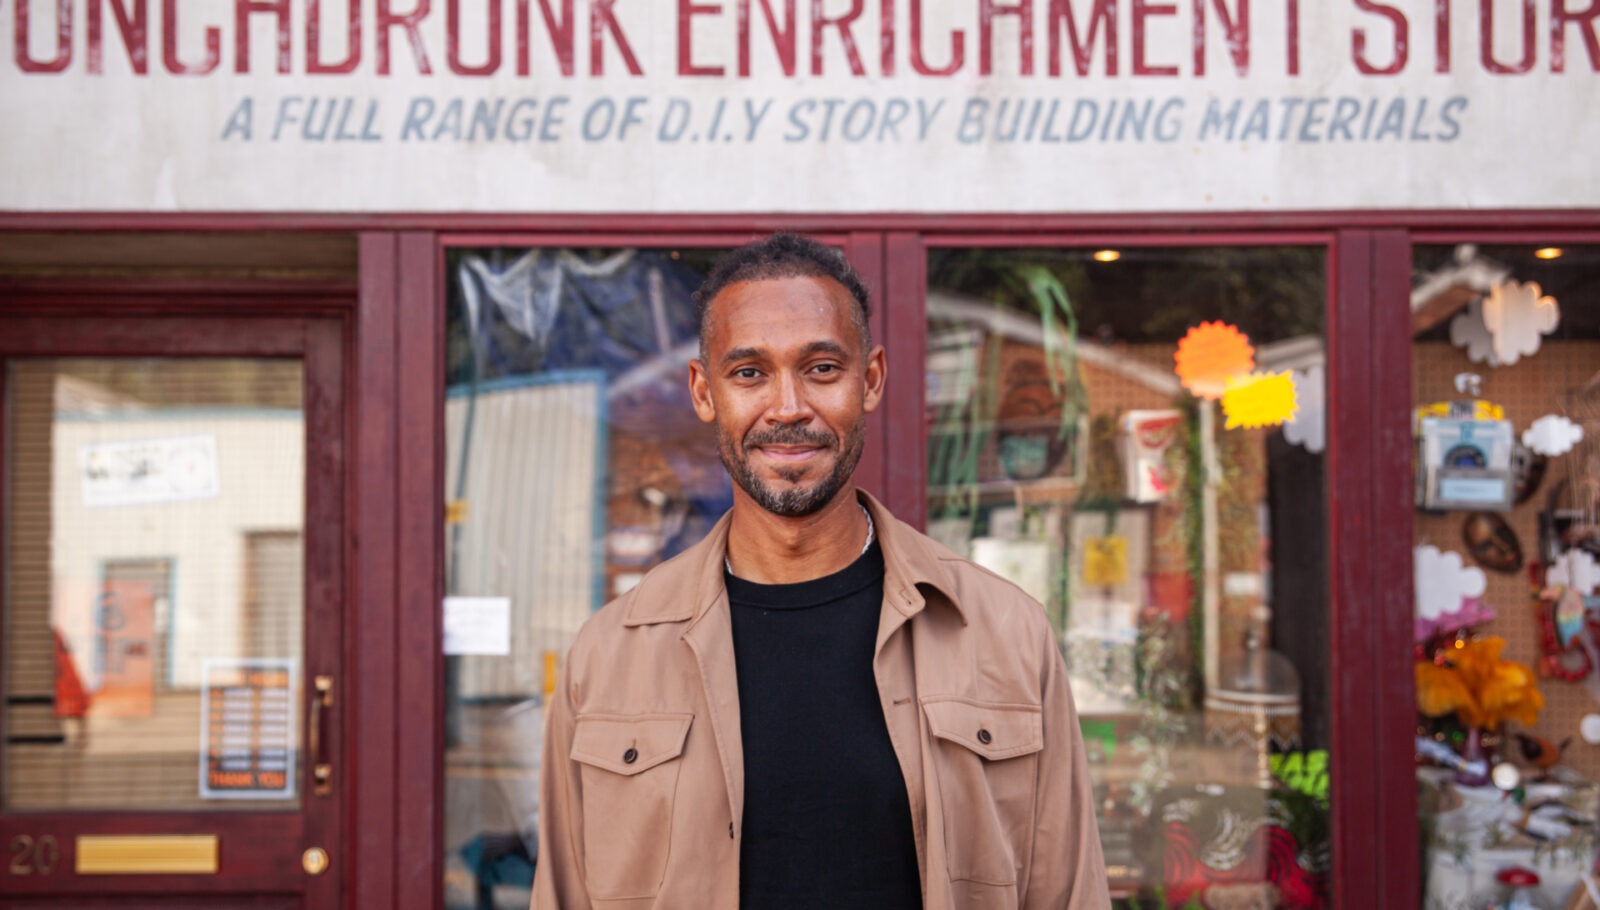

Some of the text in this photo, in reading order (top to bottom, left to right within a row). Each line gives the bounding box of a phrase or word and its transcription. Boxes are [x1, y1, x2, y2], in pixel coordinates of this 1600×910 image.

[0, 0, 645, 77] UNCHDRUNK
[221, 96, 1468, 144] A FULL RANGE OF D.I.Y STORY BUILDING MATERIALS
[257, 770, 287, 789] YOU
[9, 833, 60, 876] 20
